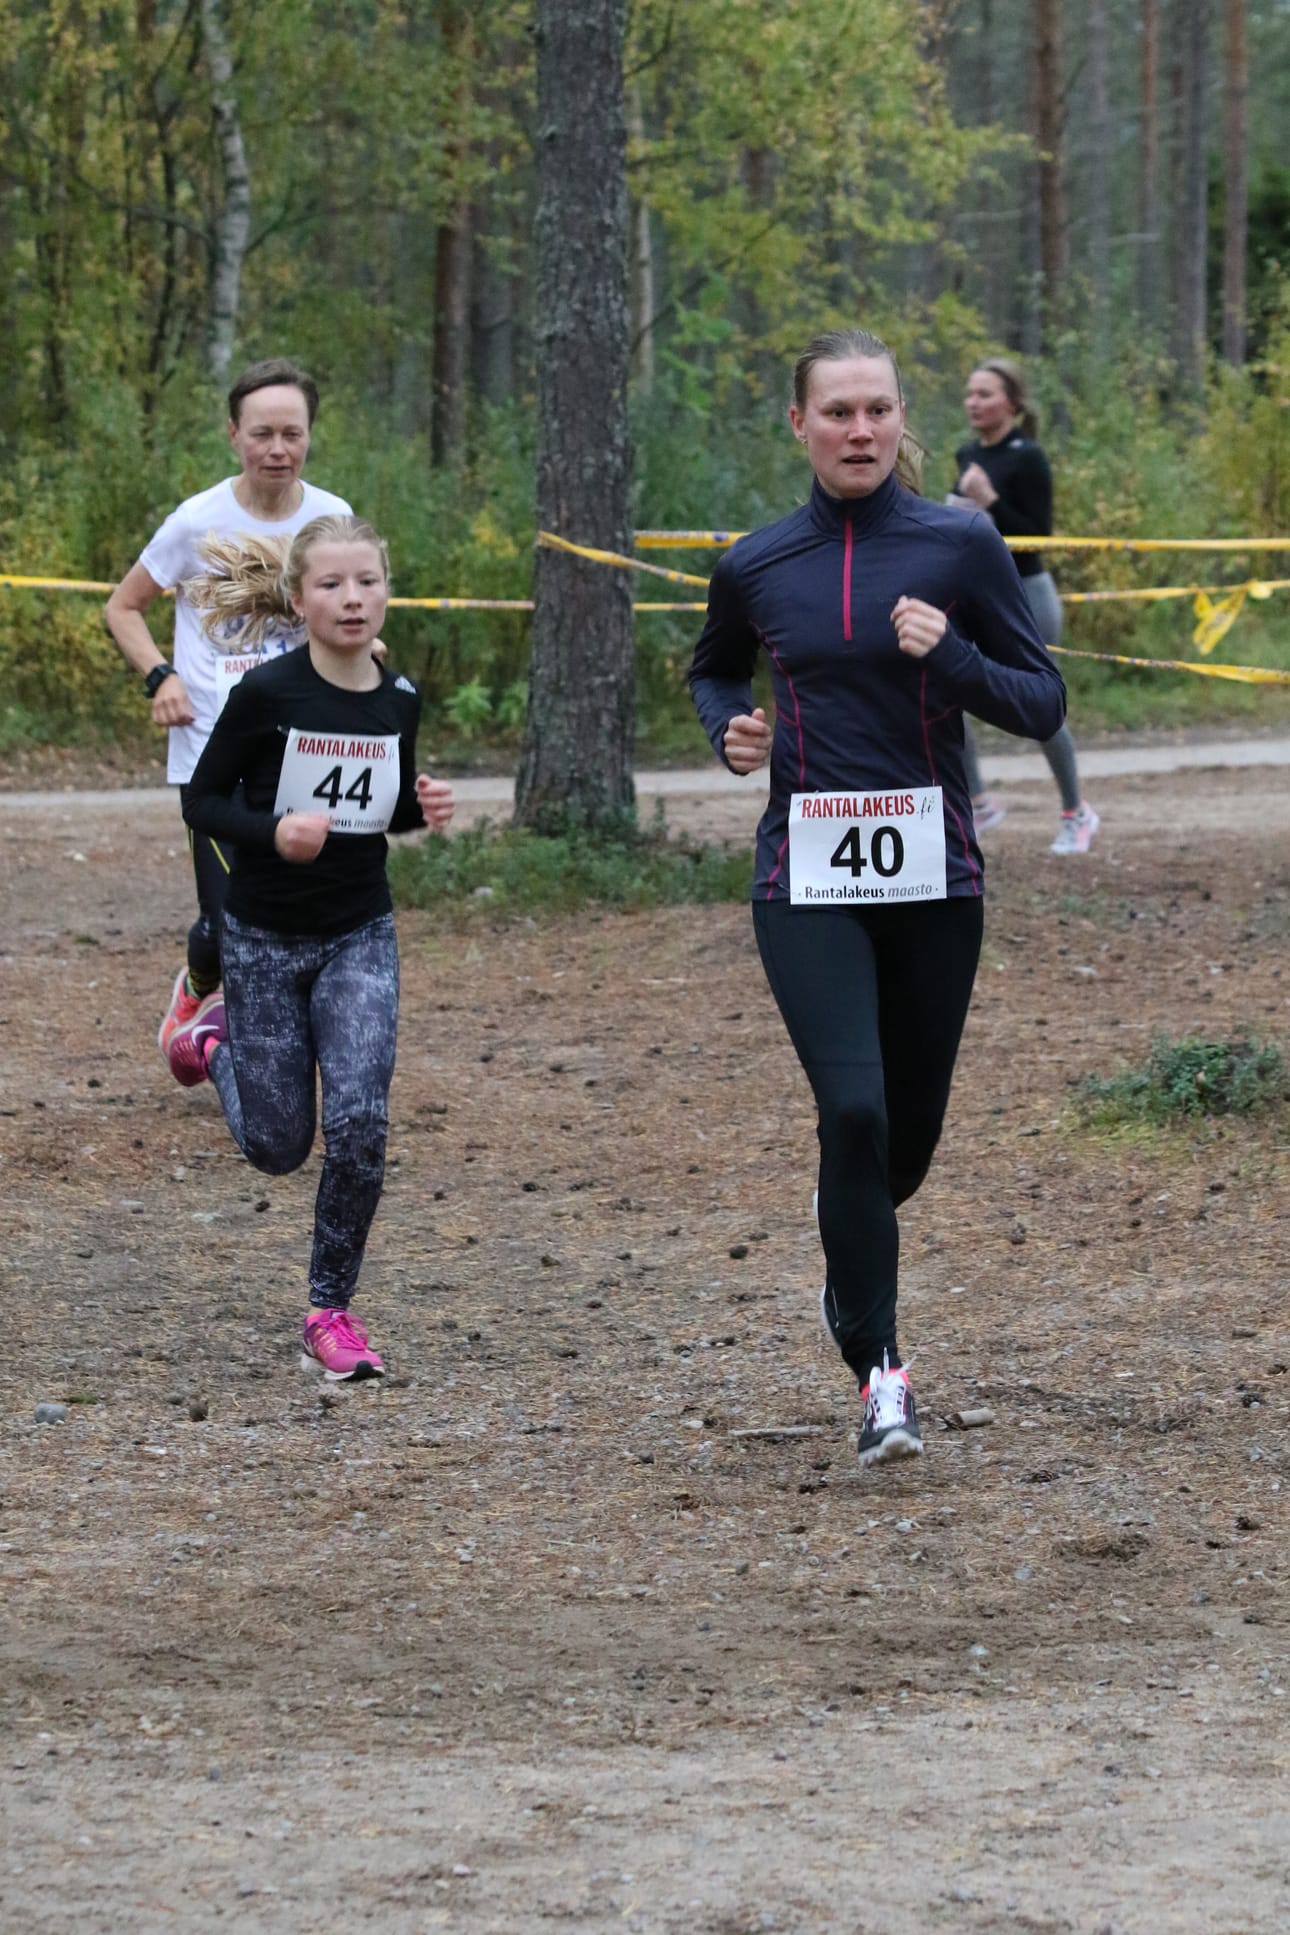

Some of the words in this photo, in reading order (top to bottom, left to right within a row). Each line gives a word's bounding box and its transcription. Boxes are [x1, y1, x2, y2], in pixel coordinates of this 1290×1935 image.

[312, 764, 373, 811] 44
[830, 825, 904, 878] 40
[805, 885, 885, 899] Rantalakeus
[887, 883, 932, 898] maasto
